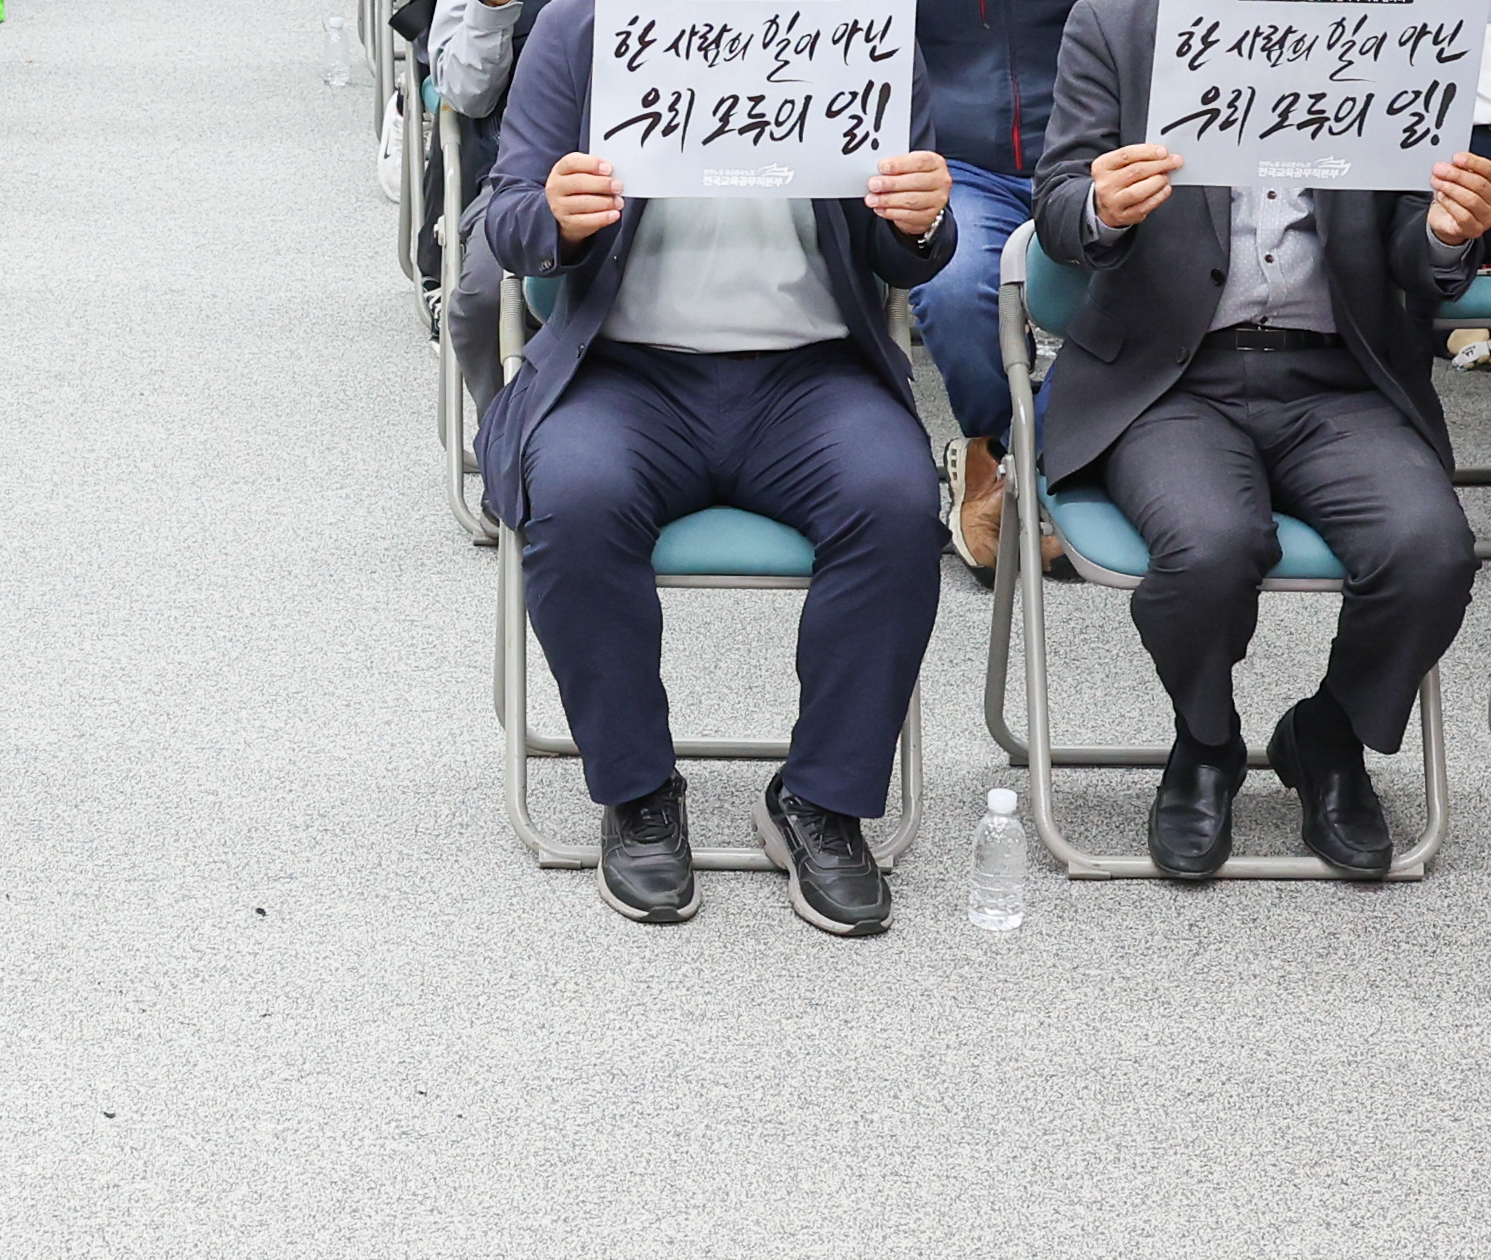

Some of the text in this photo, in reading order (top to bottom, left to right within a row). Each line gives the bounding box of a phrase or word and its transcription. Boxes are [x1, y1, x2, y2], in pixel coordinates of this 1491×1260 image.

[614, 10, 900, 82] 한 사람의 일이 아닌
[1176, 13, 1468, 81] 한 사람의 일이 아닌
[604, 79, 891, 155] 우리 모두의 일!
[1161, 79, 1456, 149] 우리 모두의 일!
